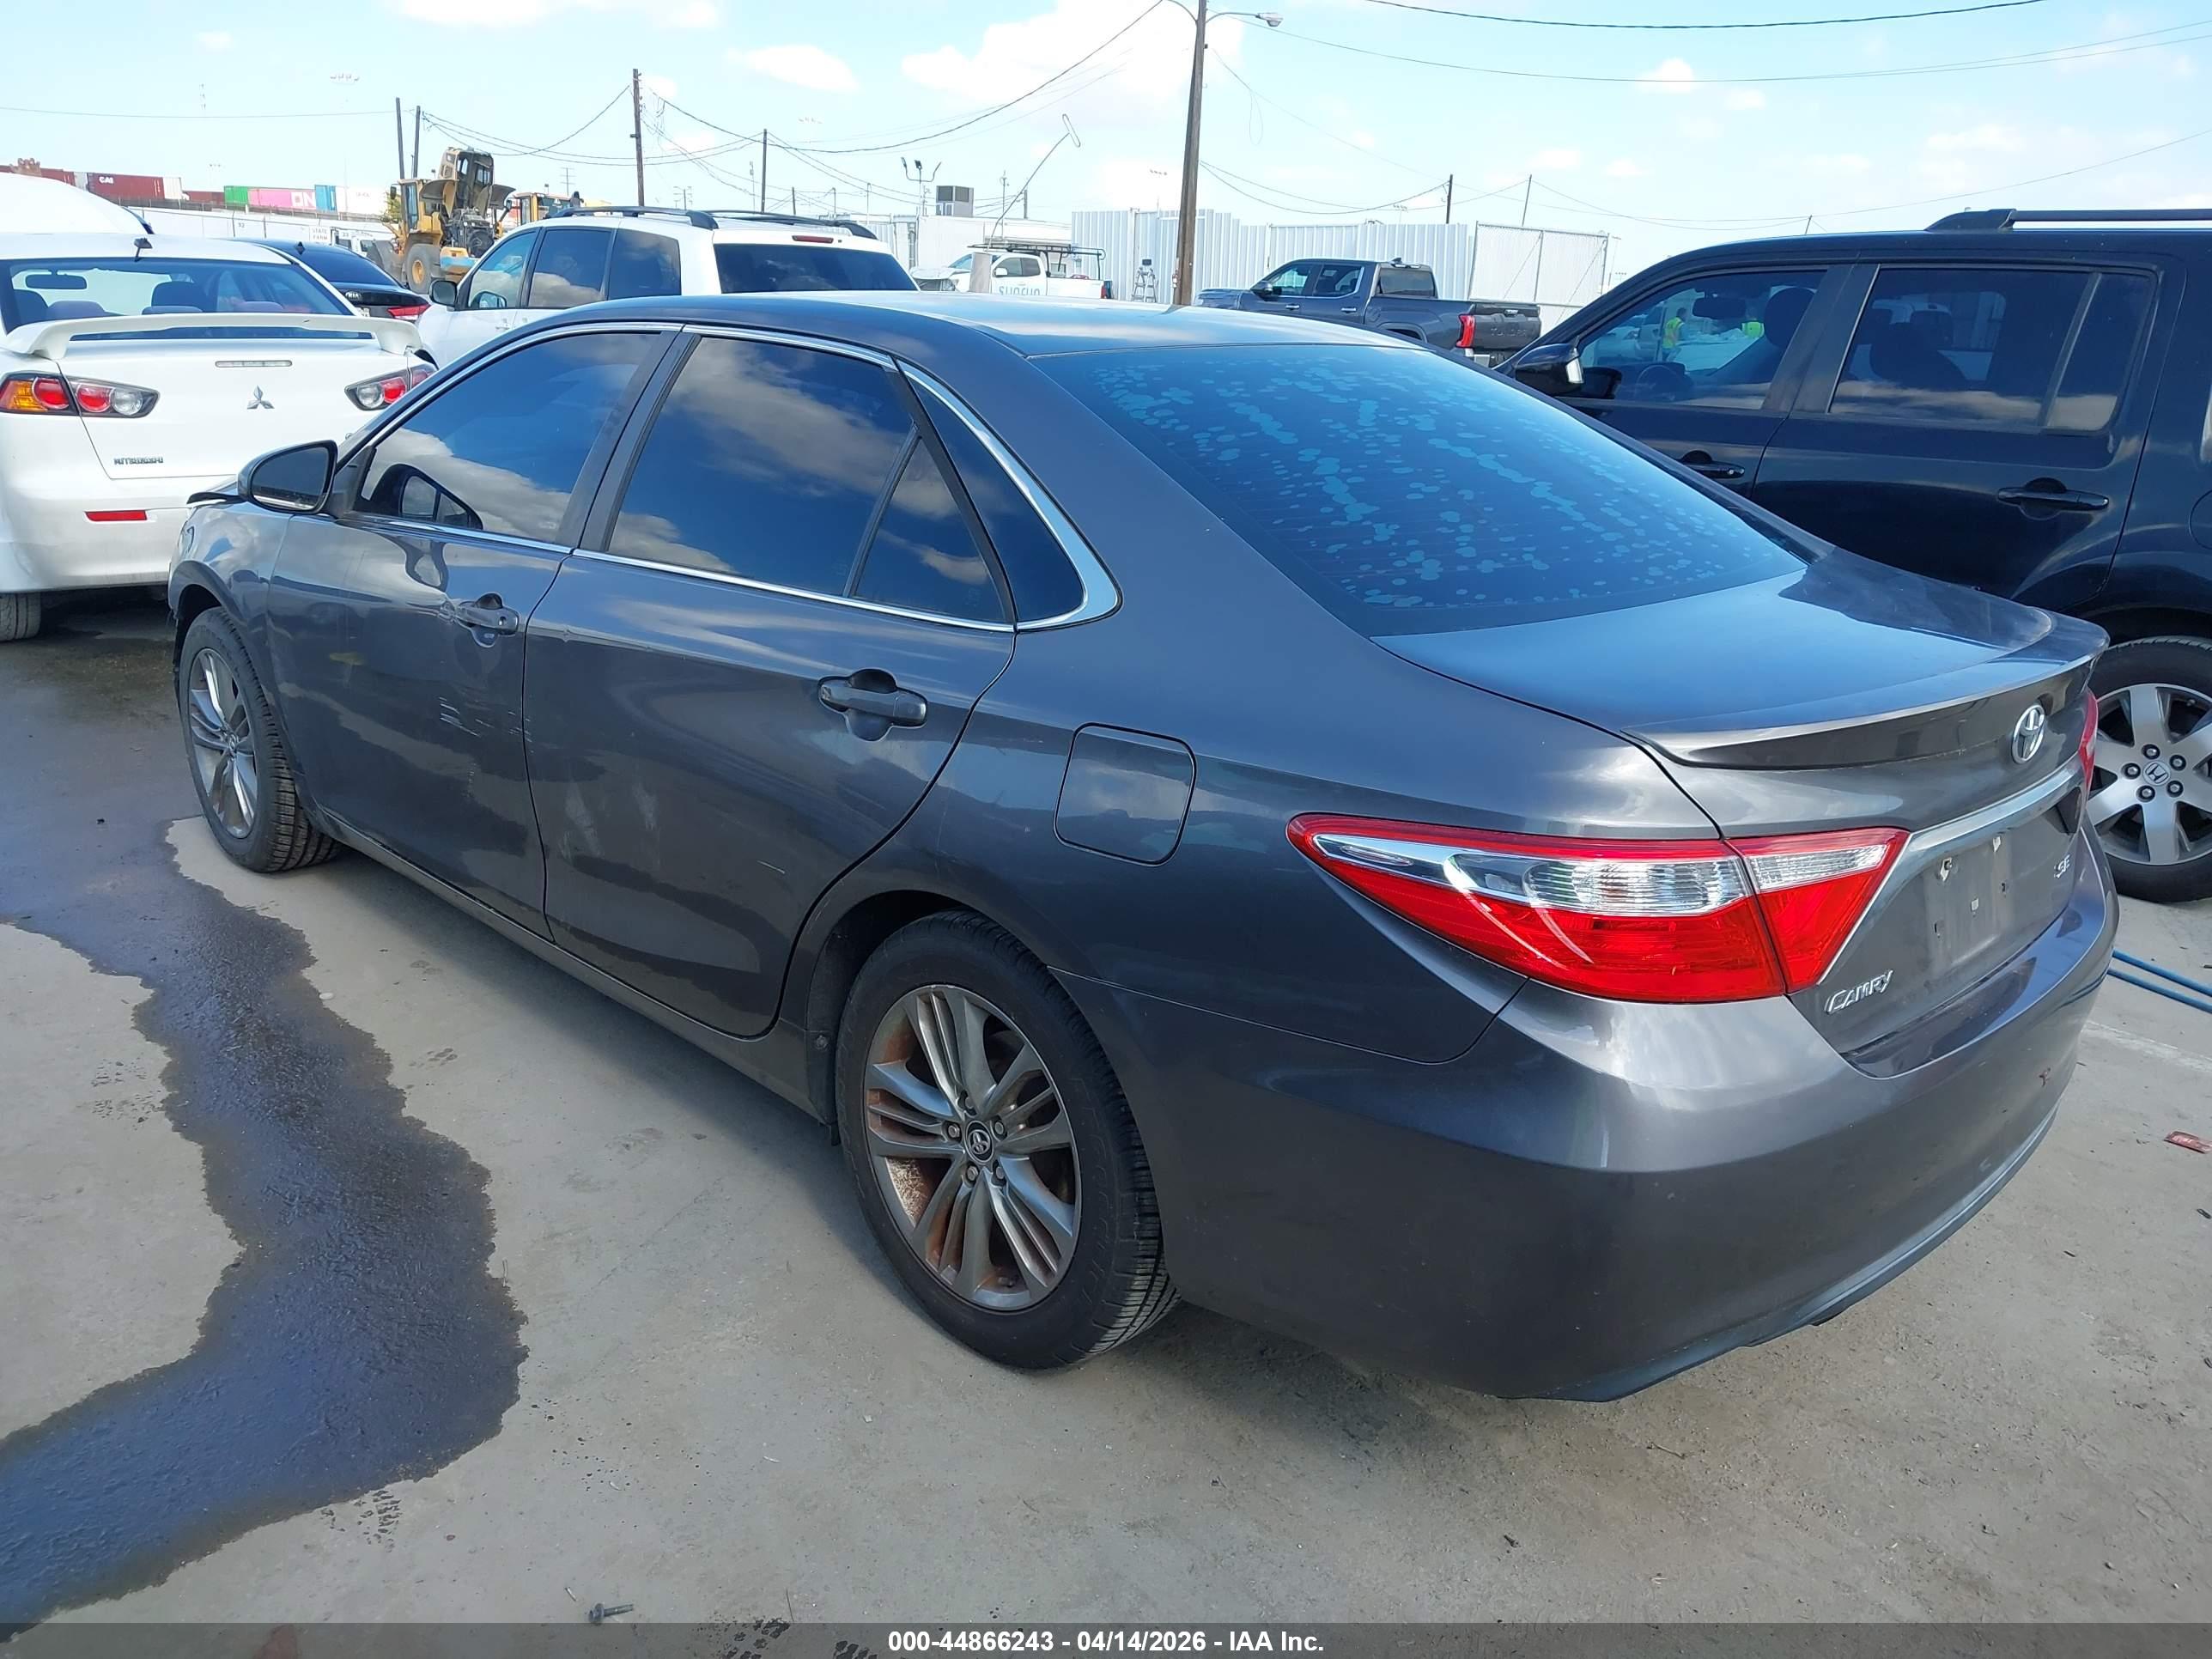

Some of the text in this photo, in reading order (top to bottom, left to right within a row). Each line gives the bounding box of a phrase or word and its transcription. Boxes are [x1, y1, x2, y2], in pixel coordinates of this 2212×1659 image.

[112, 456, 164, 465] MITSUBISHI
[2053, 854, 2070, 878] SE
[1824, 969, 1893, 1013] CAMRY
